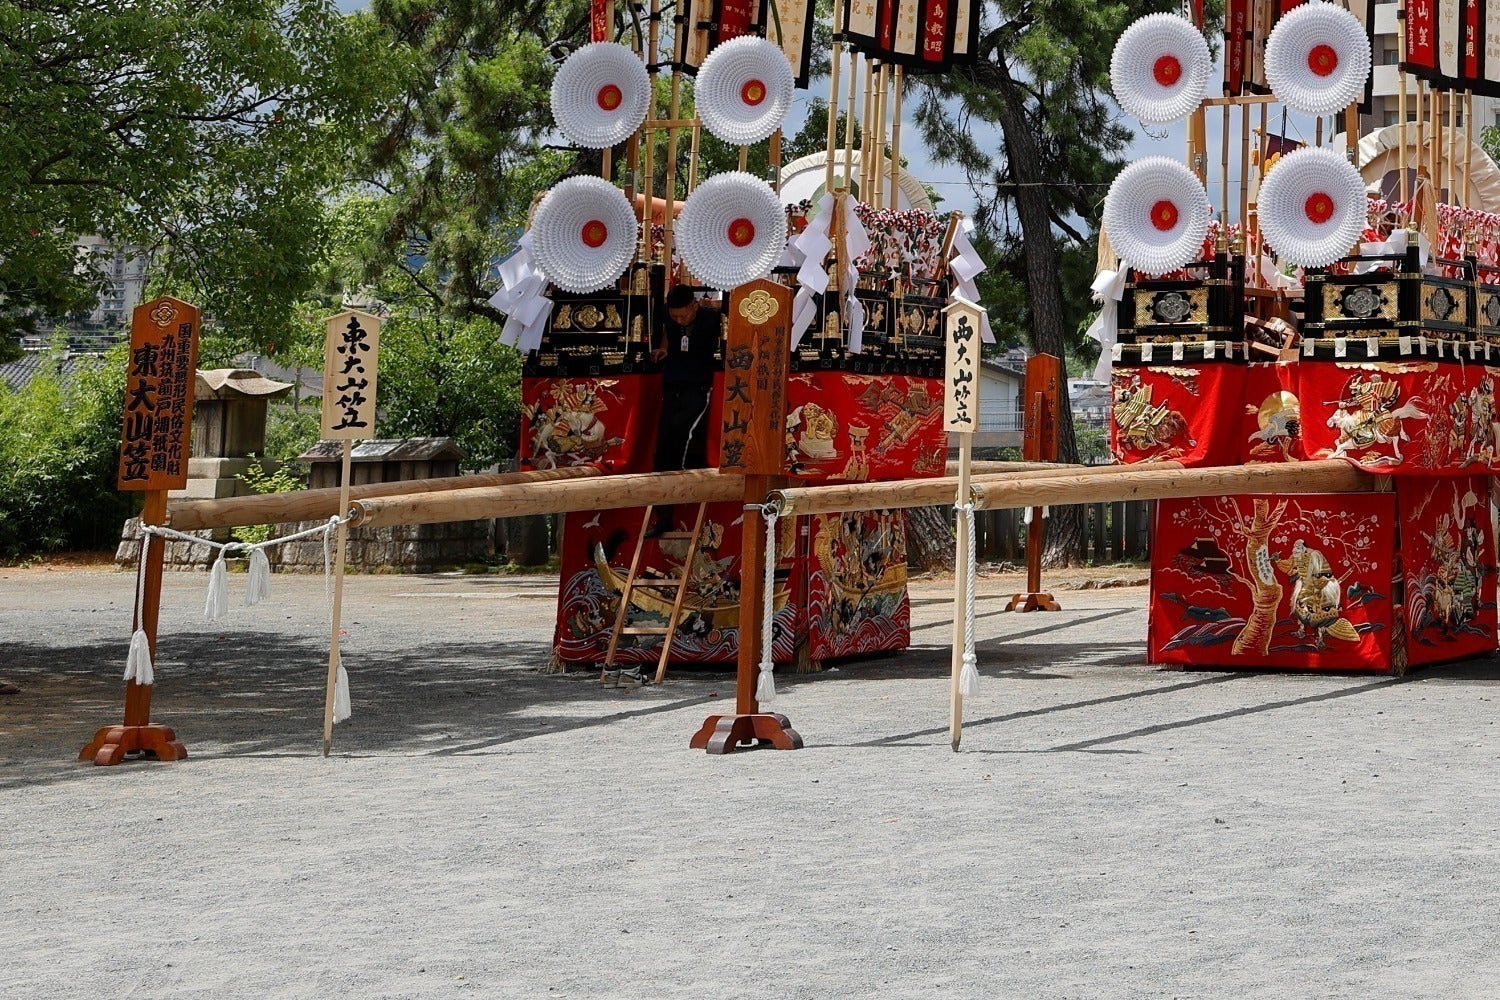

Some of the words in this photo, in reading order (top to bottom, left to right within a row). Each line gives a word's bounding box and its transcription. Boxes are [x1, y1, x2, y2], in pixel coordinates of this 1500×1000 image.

[122, 342, 159, 482] 東大山笠
[151, 334, 176, 472] 九州筑前戸畑祇園
[167, 323, 192, 476] 国重要無形民俗文化財
[331, 316, 370, 430] 東大山笠
[722, 344, 754, 468] 西大山笠
[950, 315, 973, 425] 西大山笠
